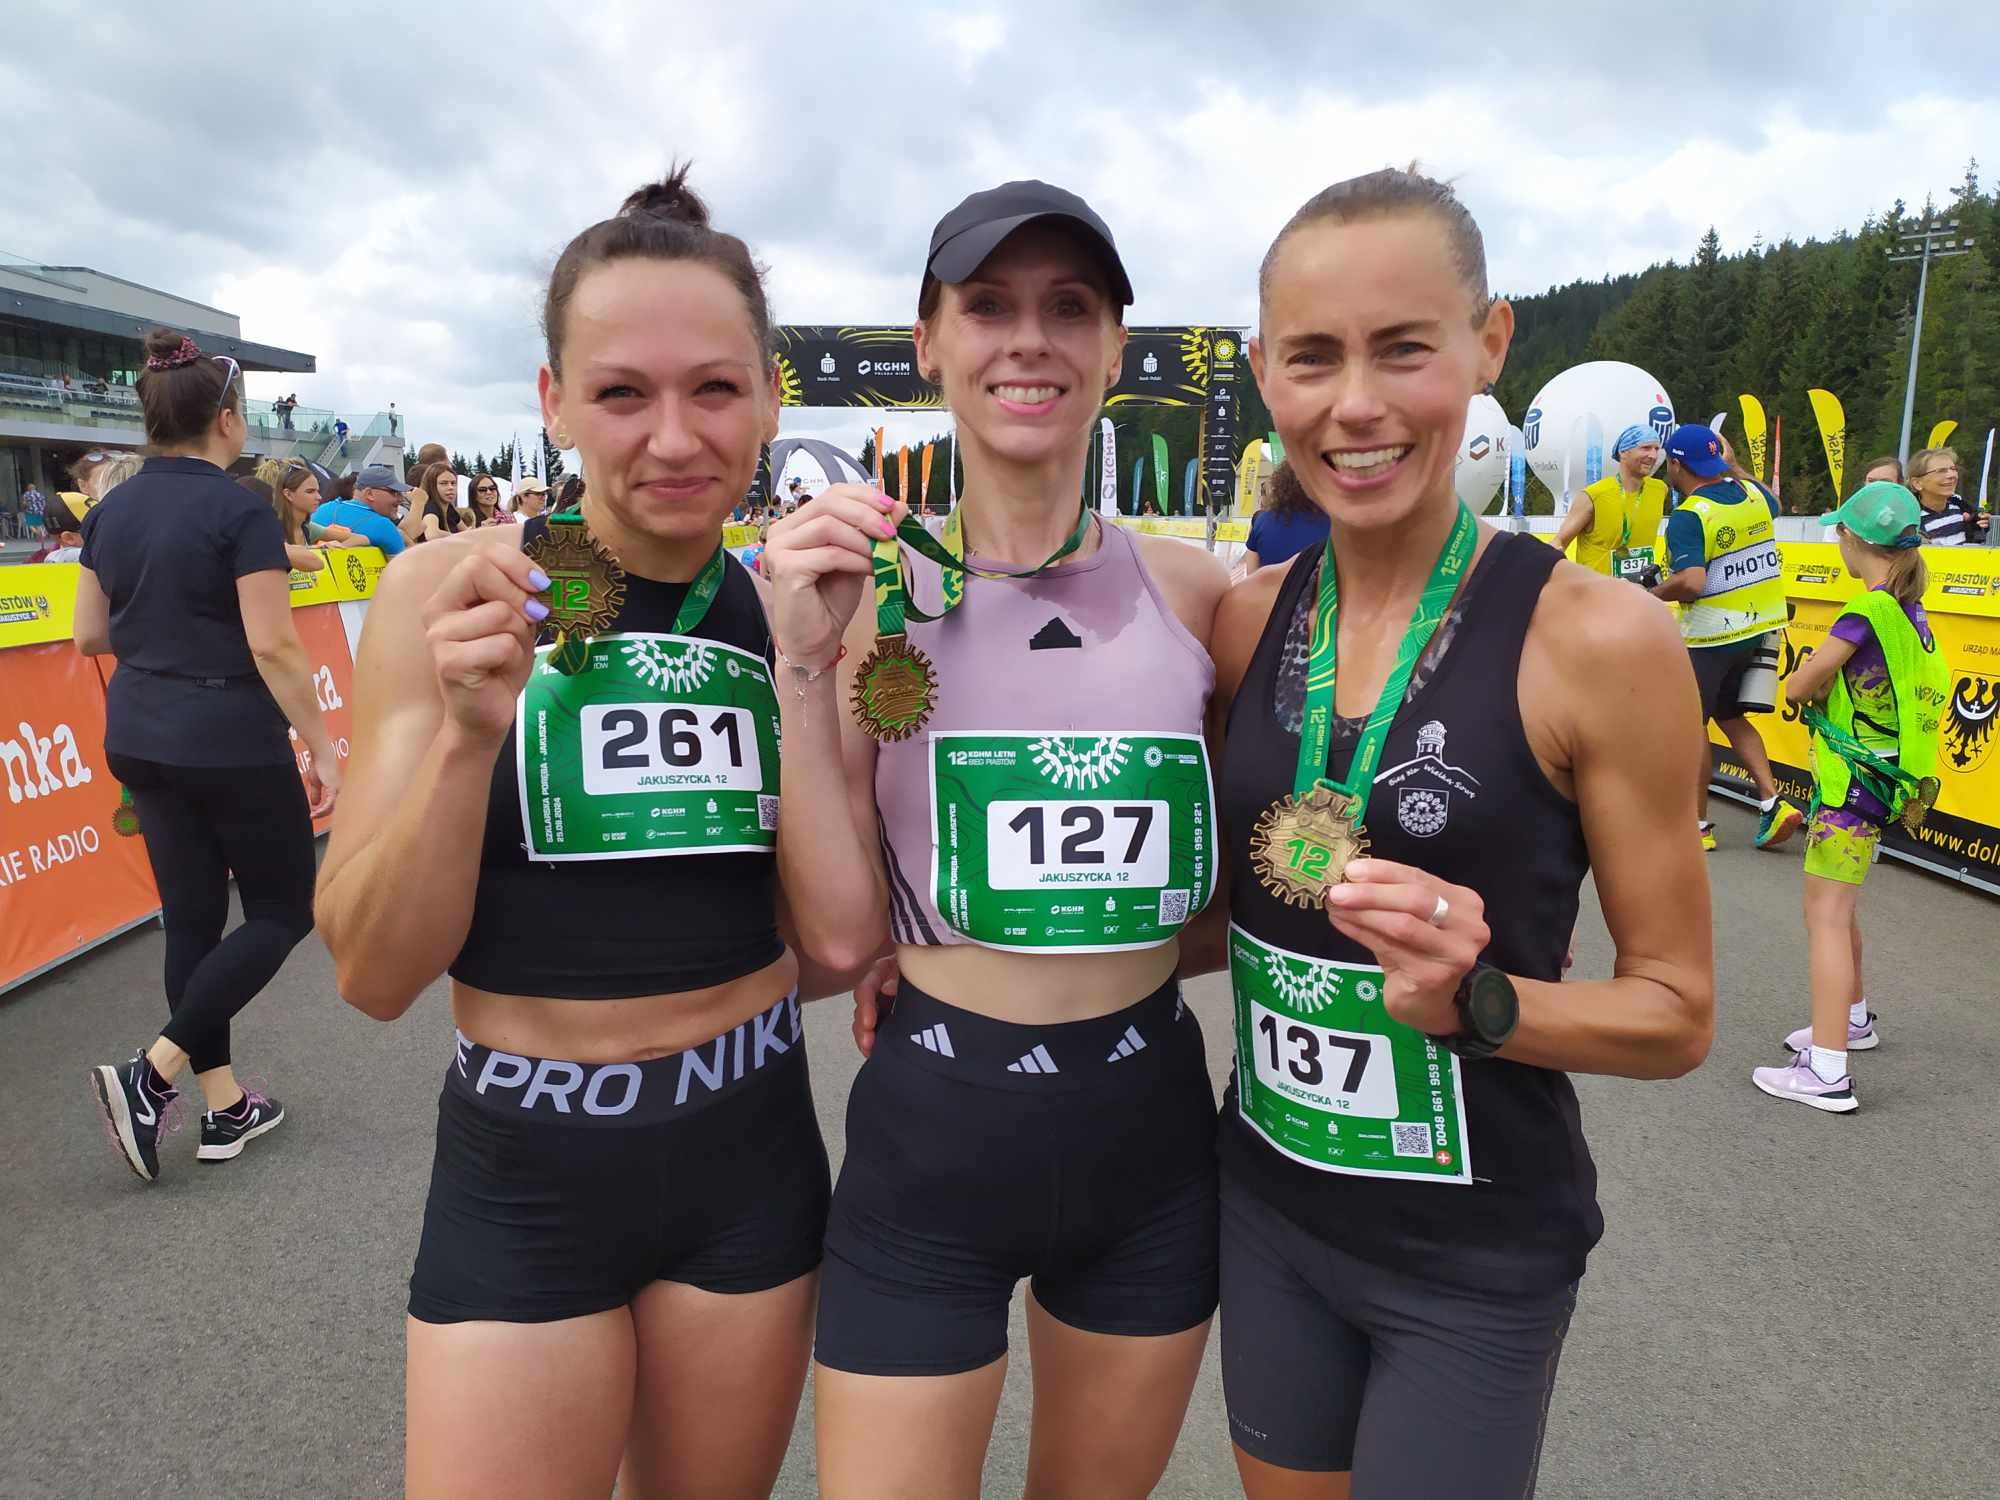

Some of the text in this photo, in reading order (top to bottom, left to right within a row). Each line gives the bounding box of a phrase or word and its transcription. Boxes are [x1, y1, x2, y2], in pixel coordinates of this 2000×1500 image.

[874, 362, 910, 372] KGHM
[1105, 433, 1115, 478] KGHM
[1440, 555, 1461, 577] 12
[1624, 559, 1645, 570] 337
[1724, 551, 1777, 580] PHOTO
[549, 579, 591, 611] 12
[1310, 705, 1327, 724] 12
[601, 708, 743, 769] 261
[947, 751, 968, 766] 12
[637, 774, 728, 786] JAKUSZYCKA 12
[28, 825, 99, 874] RADIO
[1008, 806, 1154, 865] 127
[1190, 802, 1204, 911] 0048 661 959 221
[1285, 838, 1332, 881] 12
[1039, 872, 1129, 883] JAKUSZYCKA 12
[1259, 1014, 1372, 1093] 137
[475, 1051, 643, 1117] PRO
[1428, 1064, 1440, 1086] 959
[1276, 1081, 1350, 1110] JAKUSZYCKA 12
[1432, 1090, 1444, 1112] 661
[1435, 1116, 1447, 1146] 0048
